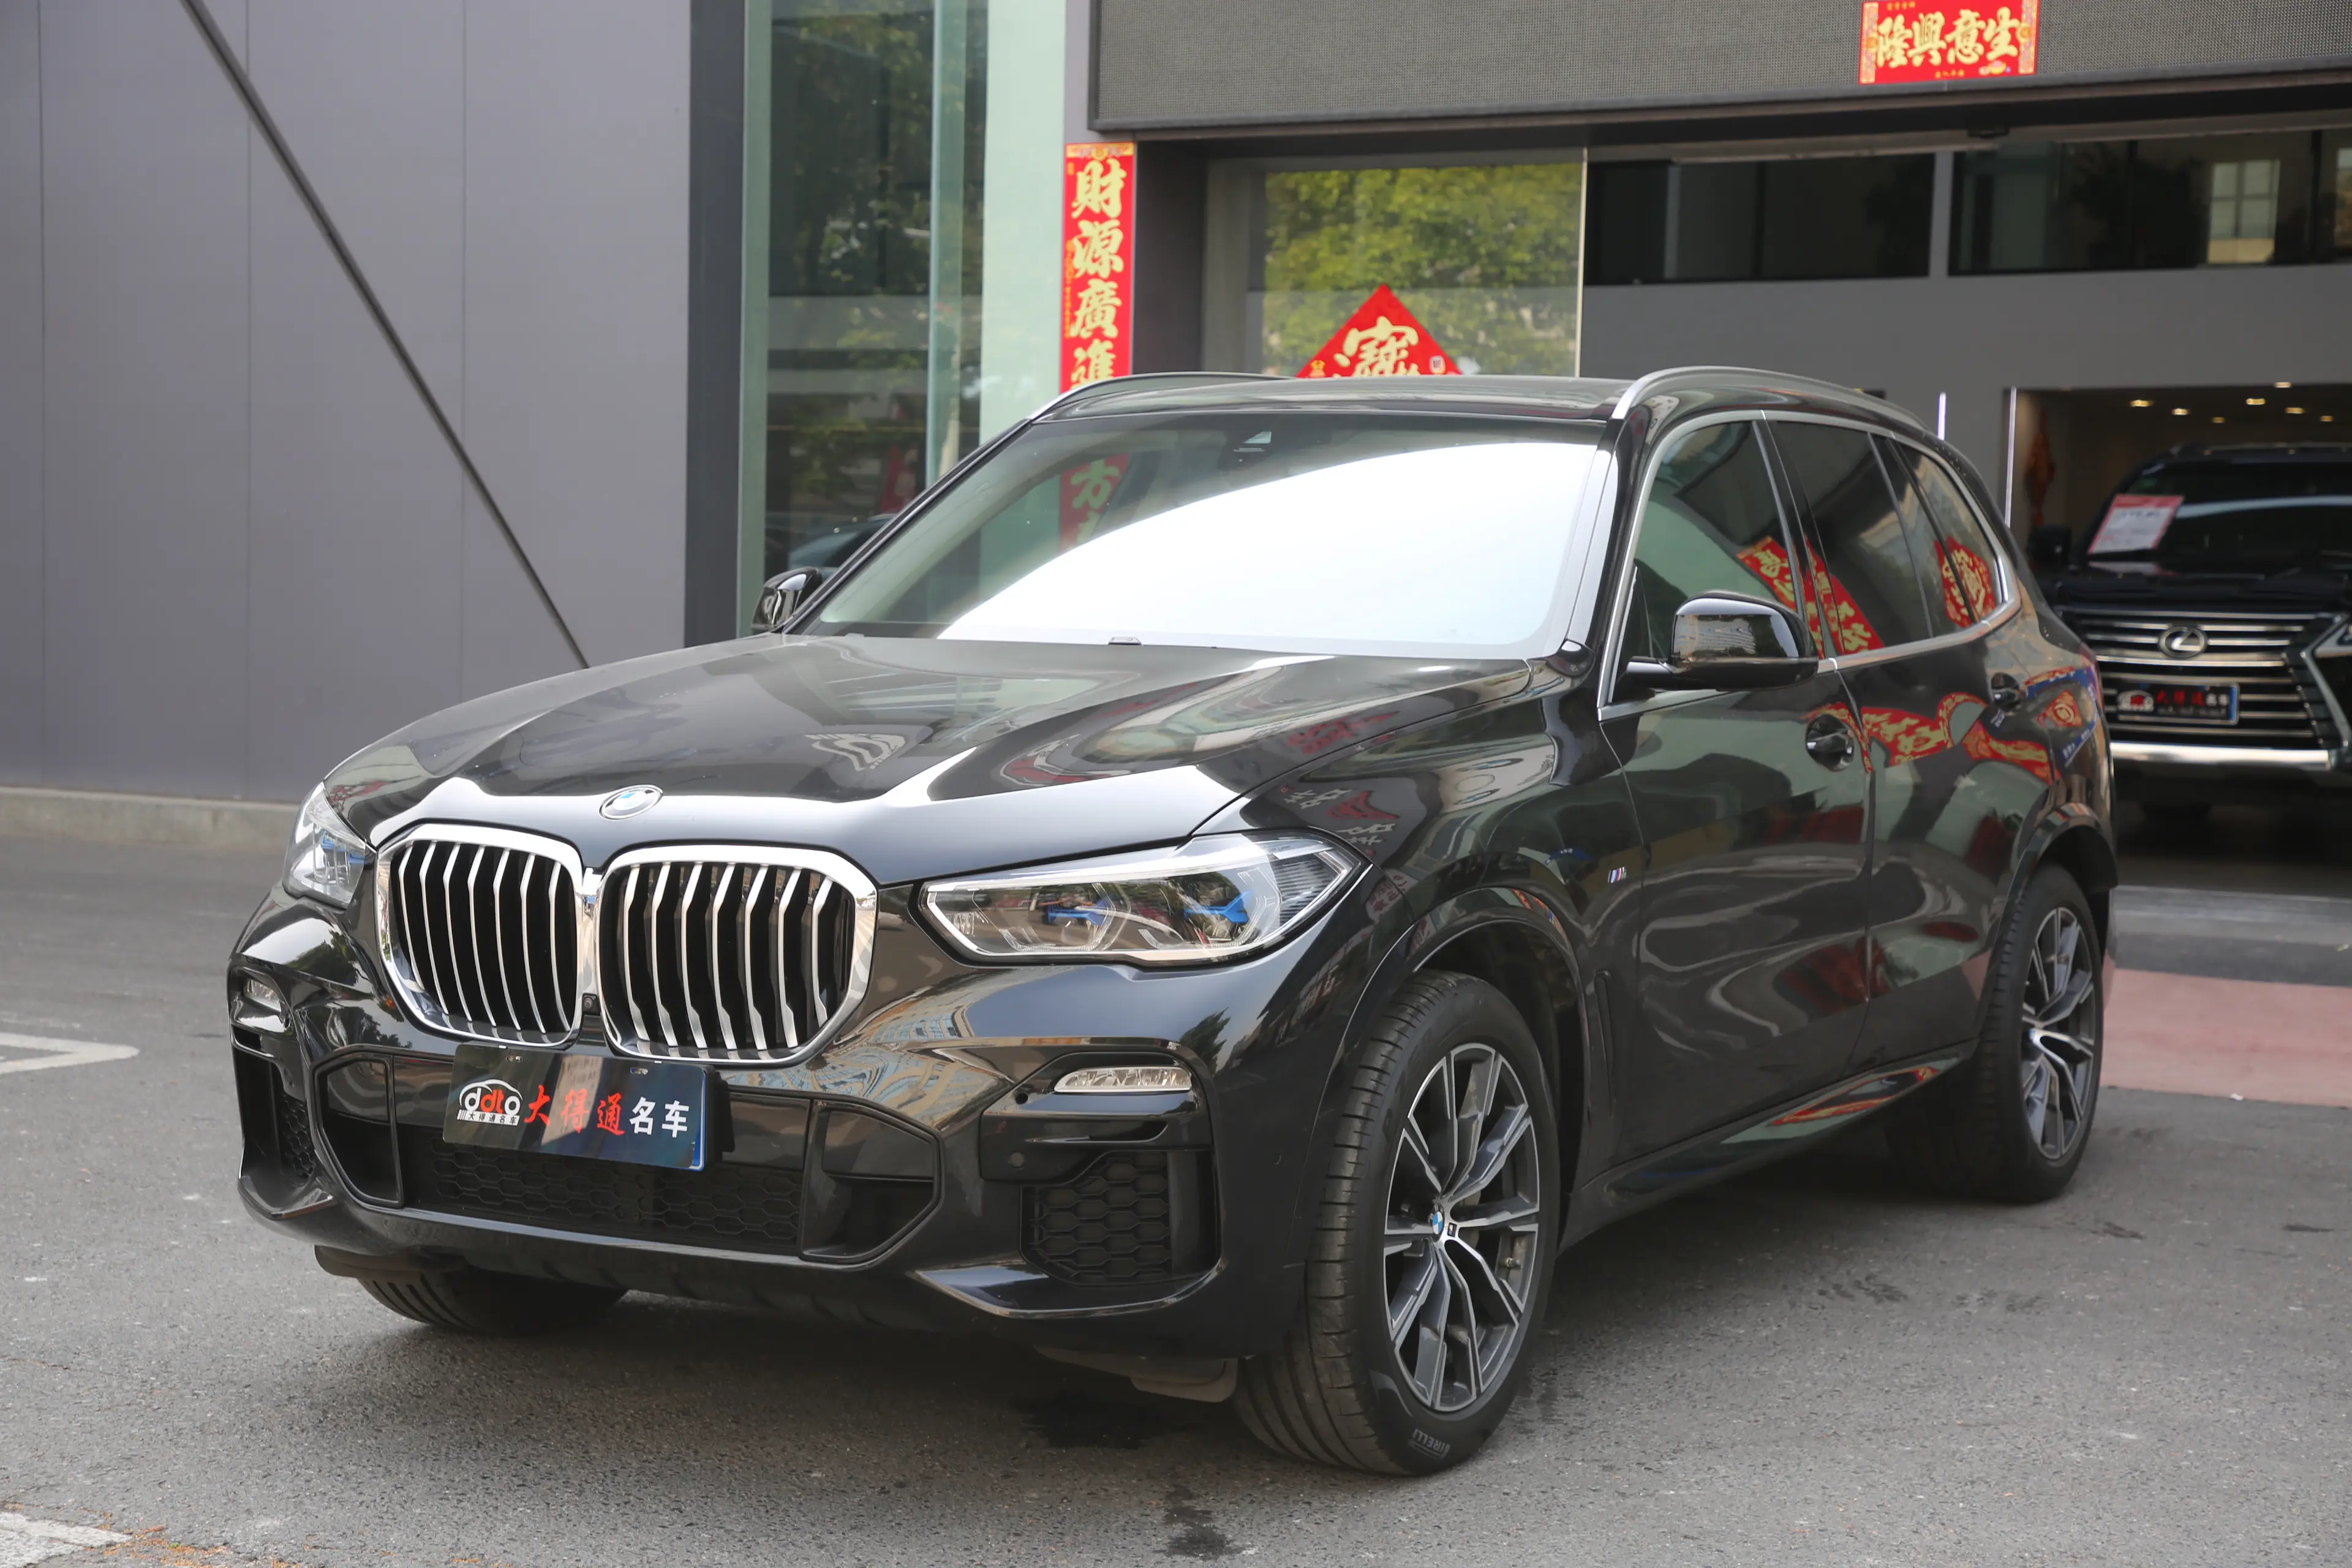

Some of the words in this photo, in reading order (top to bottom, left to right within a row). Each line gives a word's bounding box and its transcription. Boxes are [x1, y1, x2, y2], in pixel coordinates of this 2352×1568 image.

[464, 1087, 520, 1115] ddto
[524, 1084, 690, 1138] 大得通名车
[467, 1112, 518, 1125] 大得通名车
